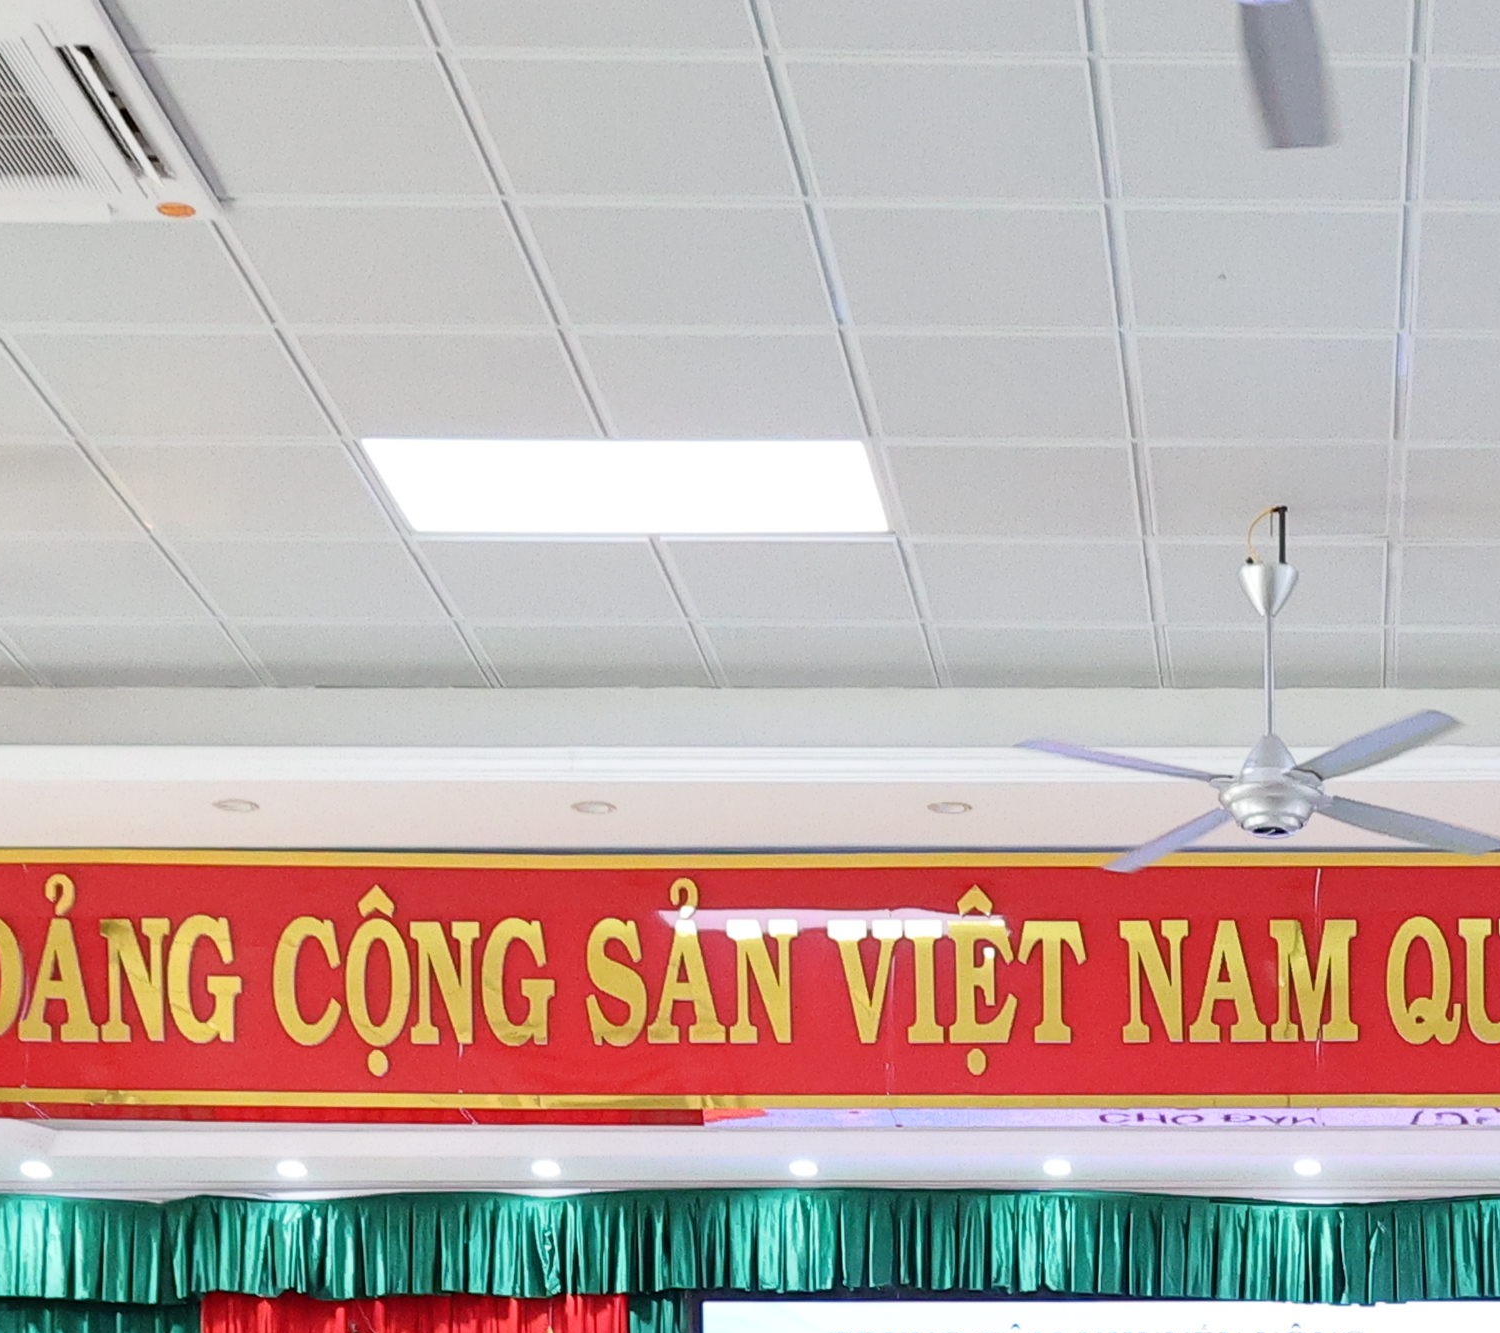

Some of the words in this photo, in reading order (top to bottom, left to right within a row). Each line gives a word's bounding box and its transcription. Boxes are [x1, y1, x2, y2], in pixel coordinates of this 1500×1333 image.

[272, 884, 556, 1077] CỘNG
[585, 876, 798, 1046] SẢN
[825, 884, 1088, 1077] VIỆT
[1118, 918, 1358, 1044] NAM
